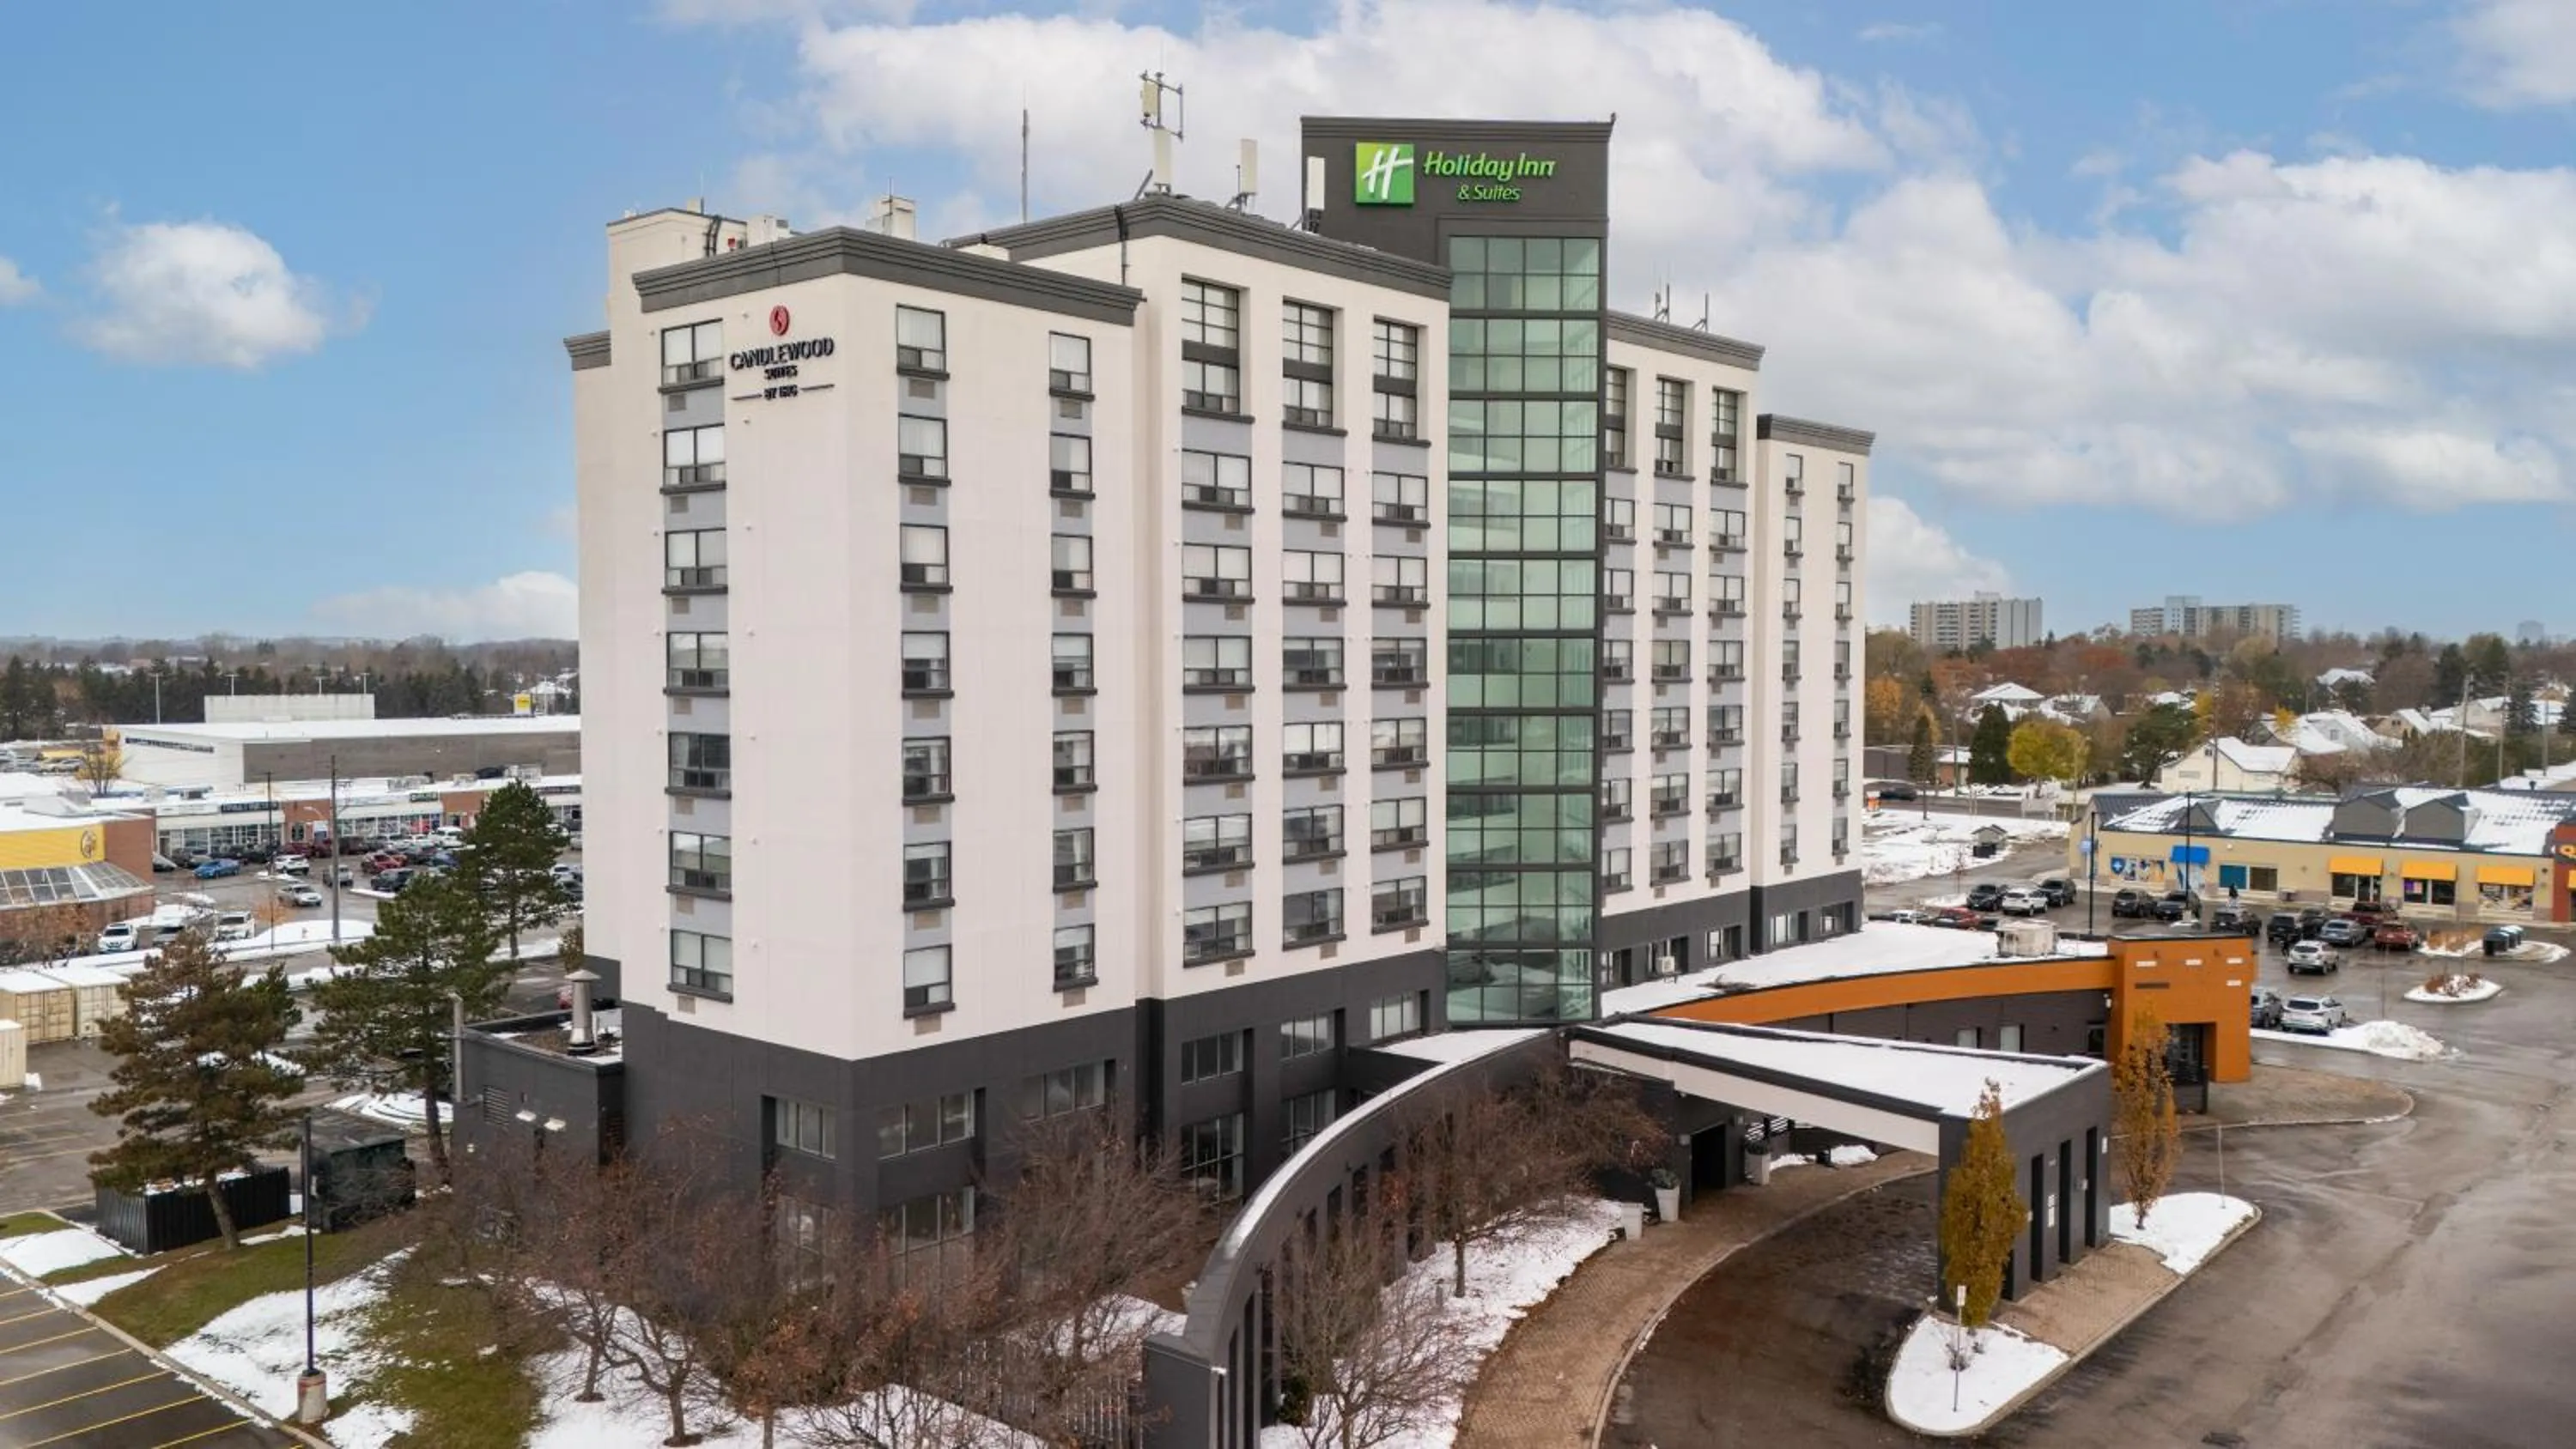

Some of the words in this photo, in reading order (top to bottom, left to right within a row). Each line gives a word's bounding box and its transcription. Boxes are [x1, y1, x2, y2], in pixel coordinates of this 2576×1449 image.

[1424, 150, 1514, 182] Holiday
[1517, 152, 1556, 177] Inn
[1457, 184, 1469, 200] &
[1473, 184, 1522, 201] Suites
[730, 337, 835, 371] CANDLEWOOD
[764, 365, 799, 380] SUITES
